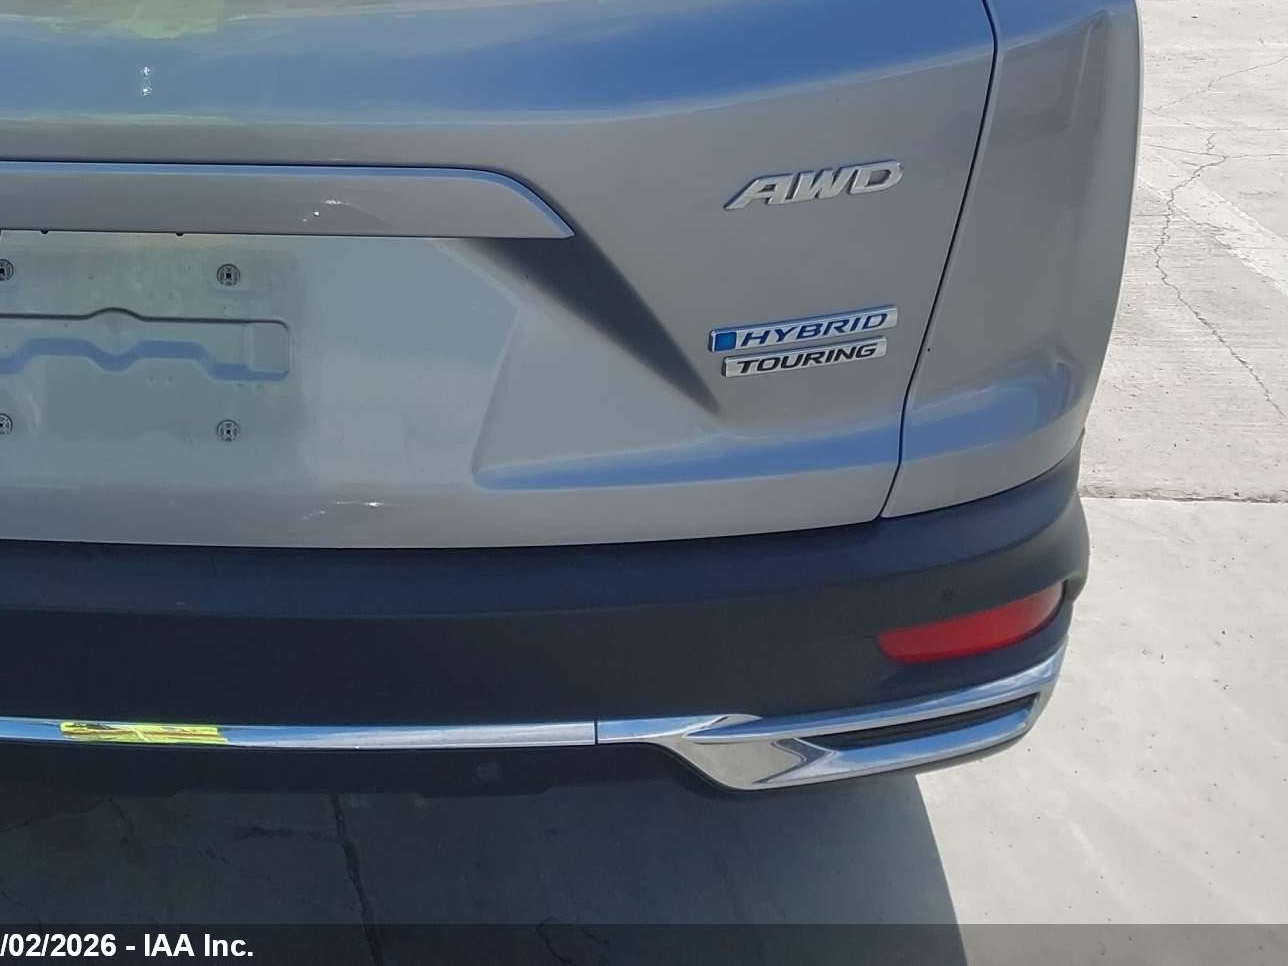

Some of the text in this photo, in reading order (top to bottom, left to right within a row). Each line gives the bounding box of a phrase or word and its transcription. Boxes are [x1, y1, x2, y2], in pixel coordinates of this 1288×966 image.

[723, 159, 904, 211] AWD
[740, 313, 888, 347] HYBRID
[737, 343, 878, 374] TOURING
